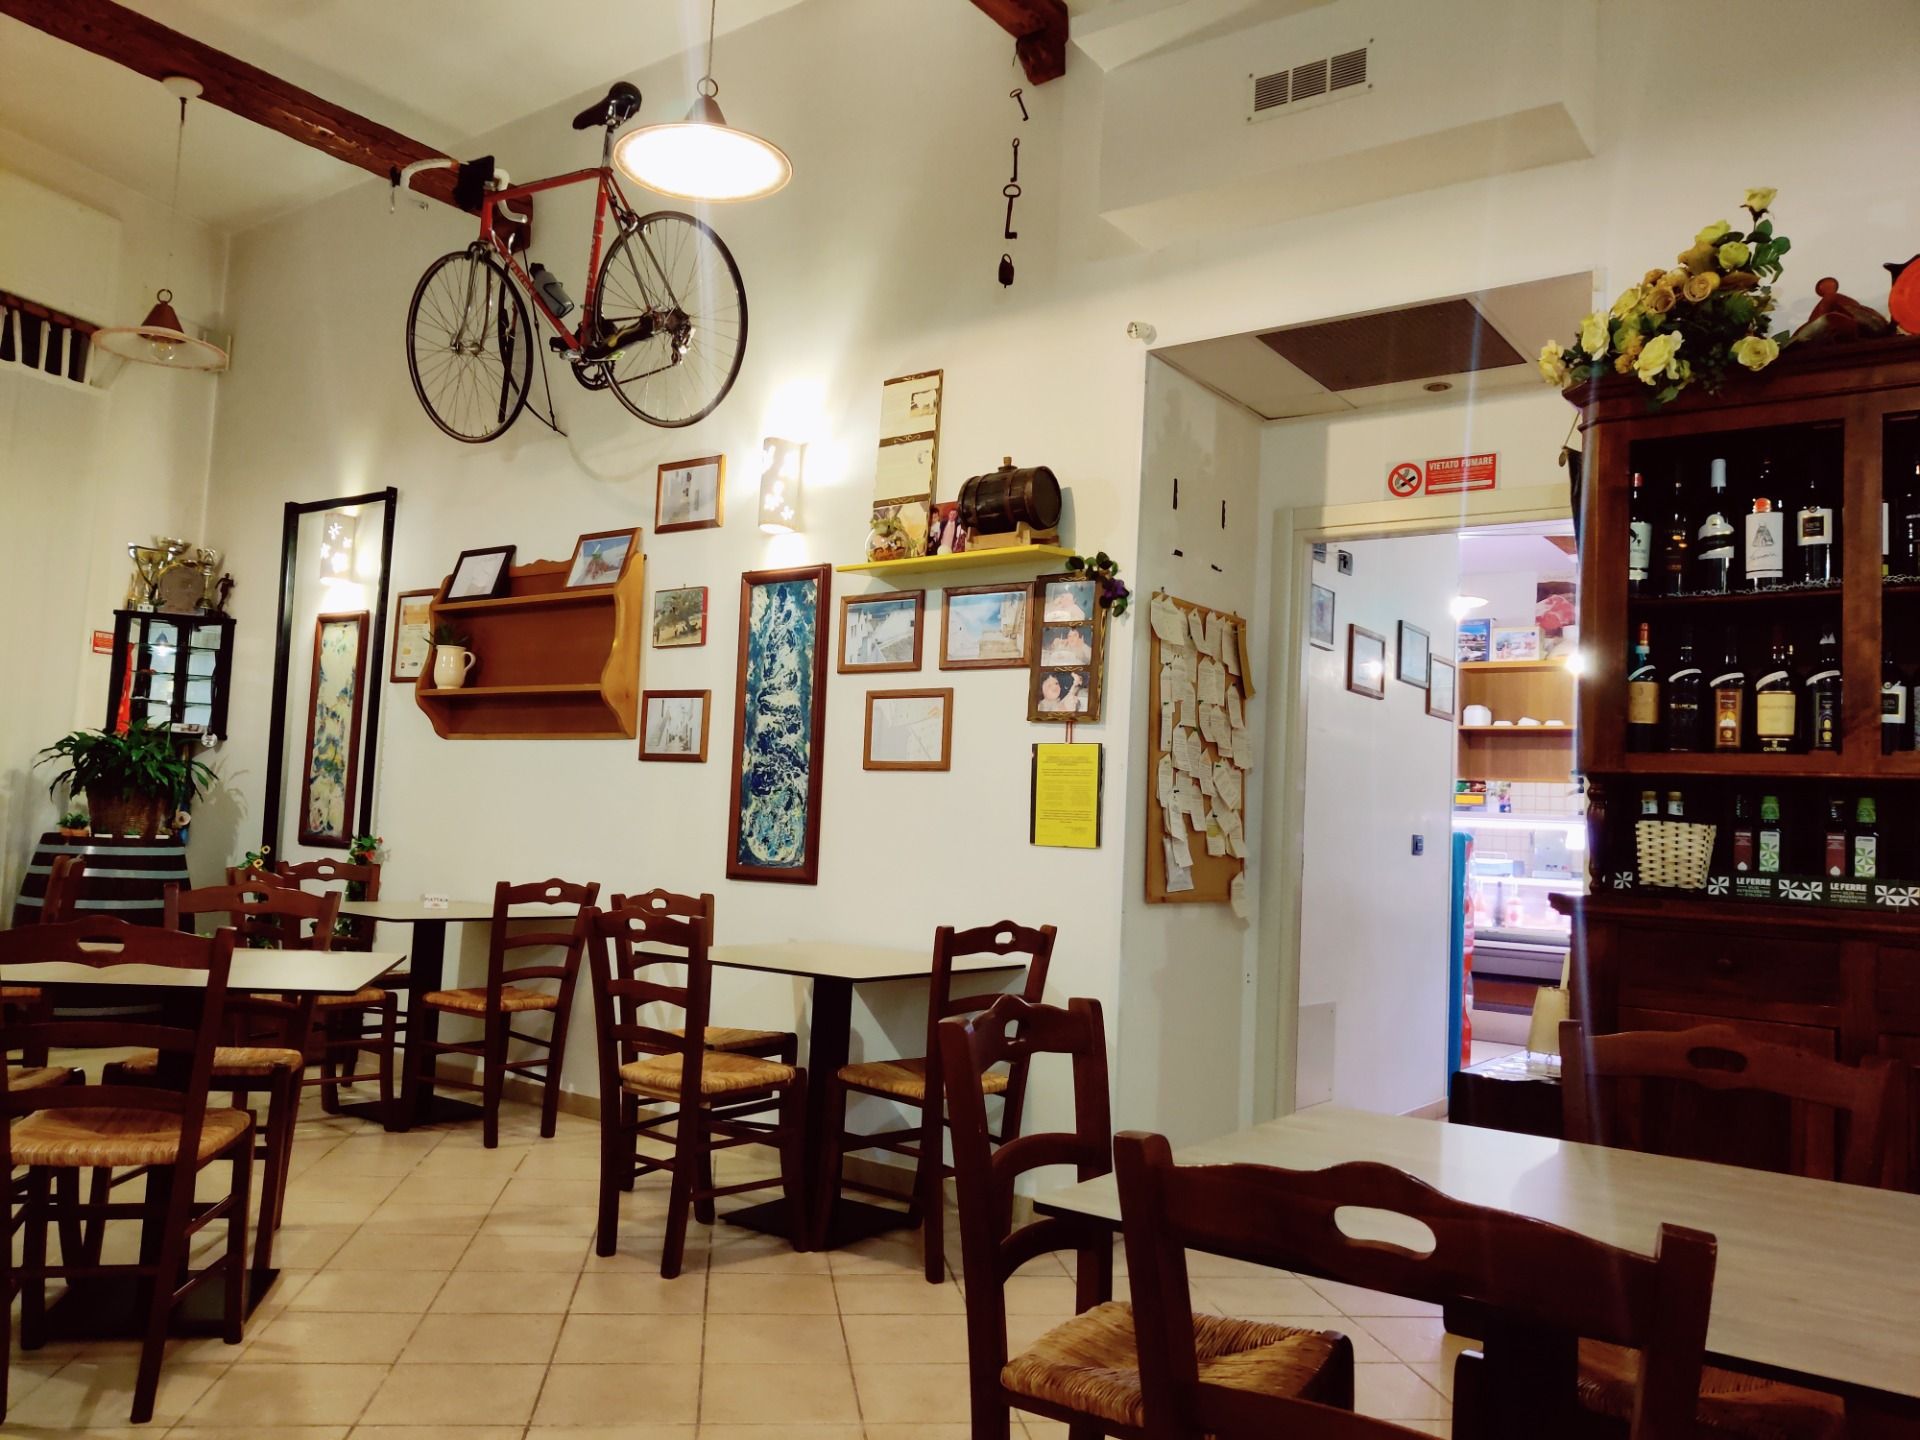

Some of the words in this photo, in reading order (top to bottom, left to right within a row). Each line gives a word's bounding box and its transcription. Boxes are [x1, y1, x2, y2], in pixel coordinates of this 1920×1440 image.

[1429, 460, 1459, 471] VIETATO
[1461, 456, 1494, 467] FUMARE
[1736, 877, 1745, 885] LE
[1746, 878, 1771, 886] FERRE
[1830, 882, 1839, 891] LE
[1840, 883, 1867, 892] FERRE
